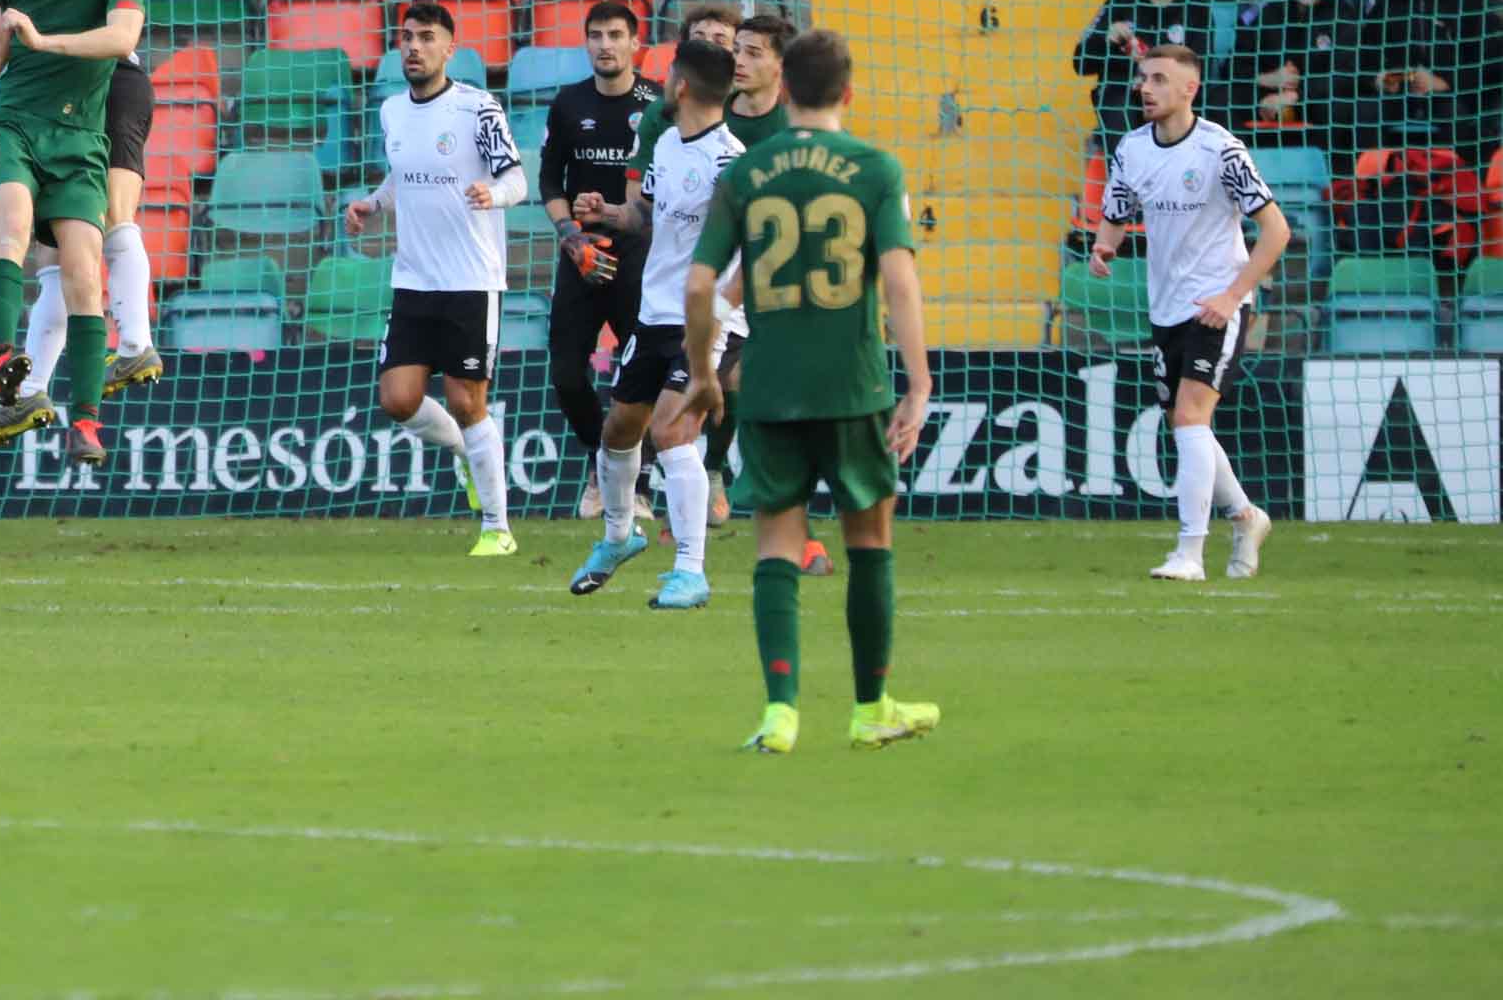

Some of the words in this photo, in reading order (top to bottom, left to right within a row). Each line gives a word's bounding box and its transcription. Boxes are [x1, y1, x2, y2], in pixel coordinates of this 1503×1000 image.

[747, 193, 867, 312] 23
[15, 406, 101, 490] E
[124, 405, 431, 493] mesón
[1346, 375, 1461, 522] A
